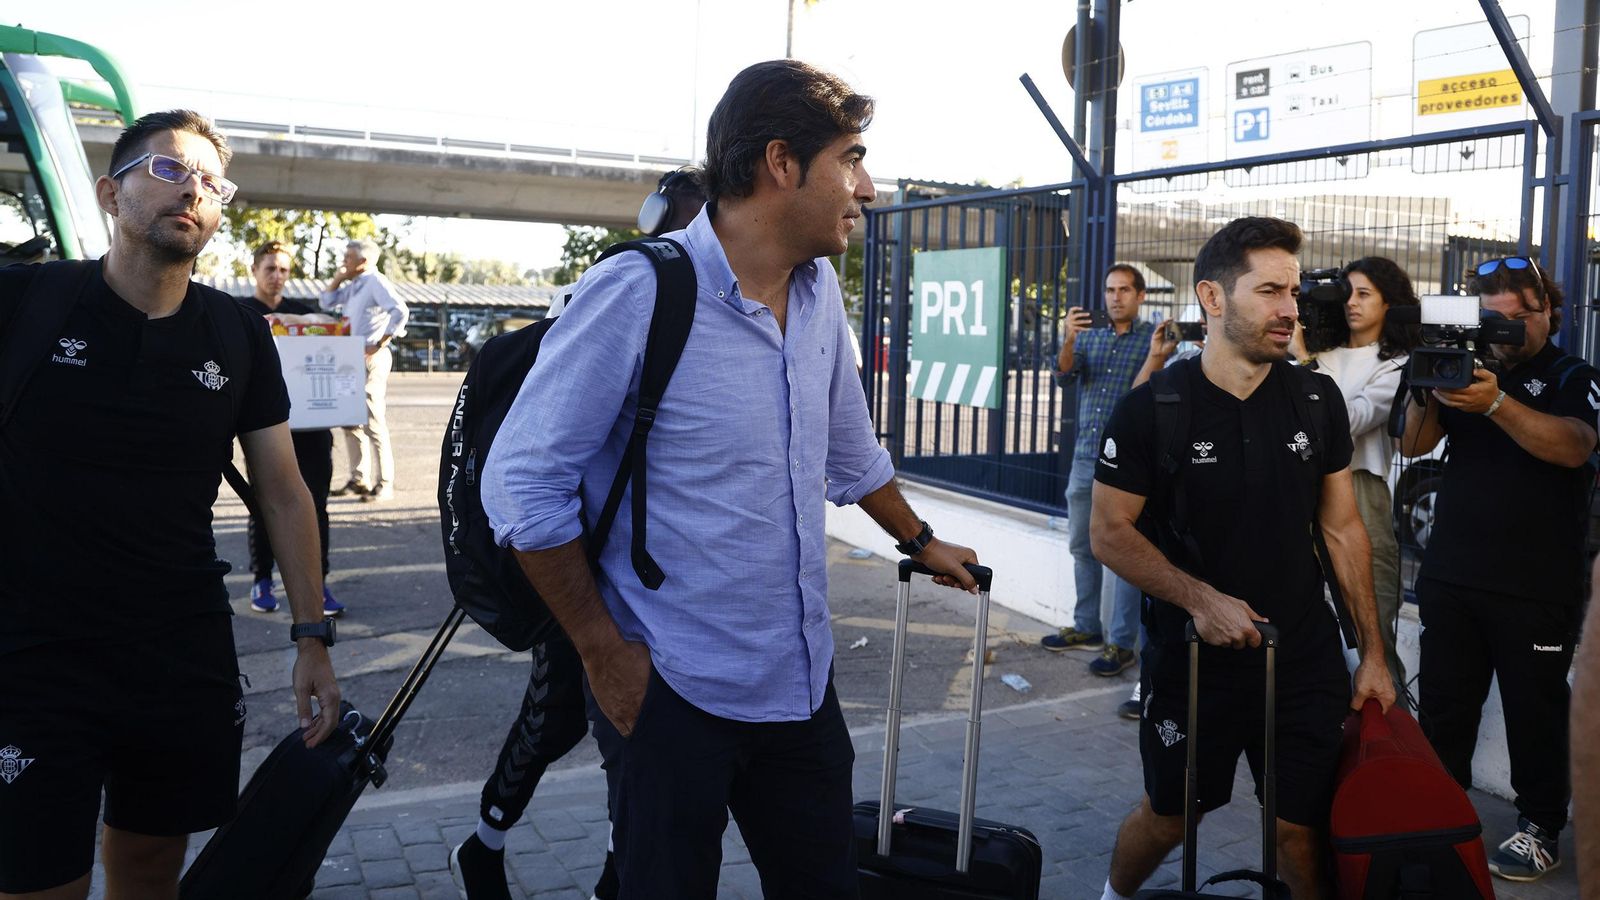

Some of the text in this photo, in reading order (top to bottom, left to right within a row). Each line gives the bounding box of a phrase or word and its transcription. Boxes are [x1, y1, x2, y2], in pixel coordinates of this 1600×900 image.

[1310, 65, 1333, 76] Bus
[1242, 73, 1265, 86] rent
[1442, 77, 1497, 93] acceso
[1149, 98, 1190, 113] Sevilla
[1311, 95, 1339, 107] Taxi
[1420, 93, 1519, 115] proveedores
[1145, 112, 1193, 128] Córdoba
[1236, 109, 1268, 140] P1
[920, 279, 988, 337] PR1
[51, 353, 87, 367] hummel
[451, 384, 469, 457] UNDER
[1191, 456, 1218, 464] hummel
[1533, 643, 1563, 652] hummel
